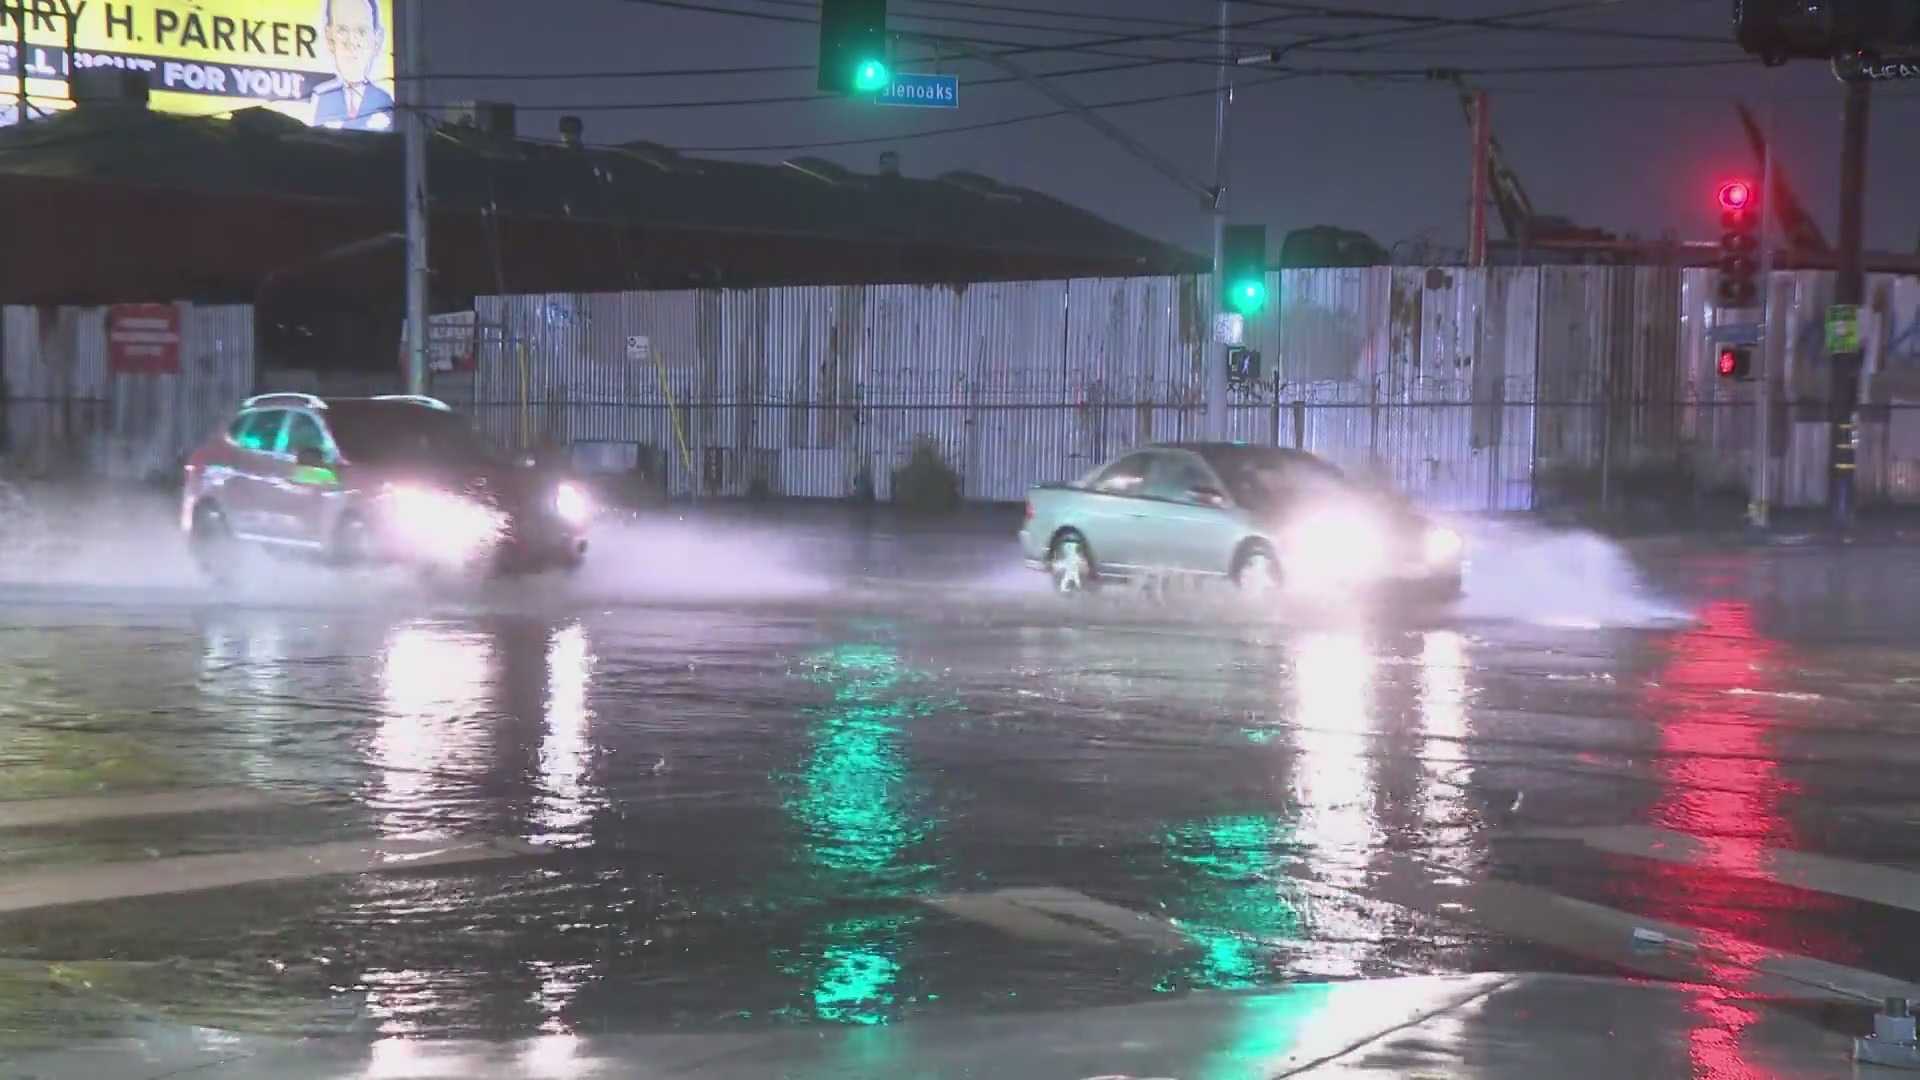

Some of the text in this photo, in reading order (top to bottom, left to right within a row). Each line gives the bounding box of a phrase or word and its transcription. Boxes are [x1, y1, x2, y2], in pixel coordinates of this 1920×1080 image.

[104, 2, 142, 41] H.
[155, 8, 318, 59] PARKER
[163, 61, 226, 93] FOR
